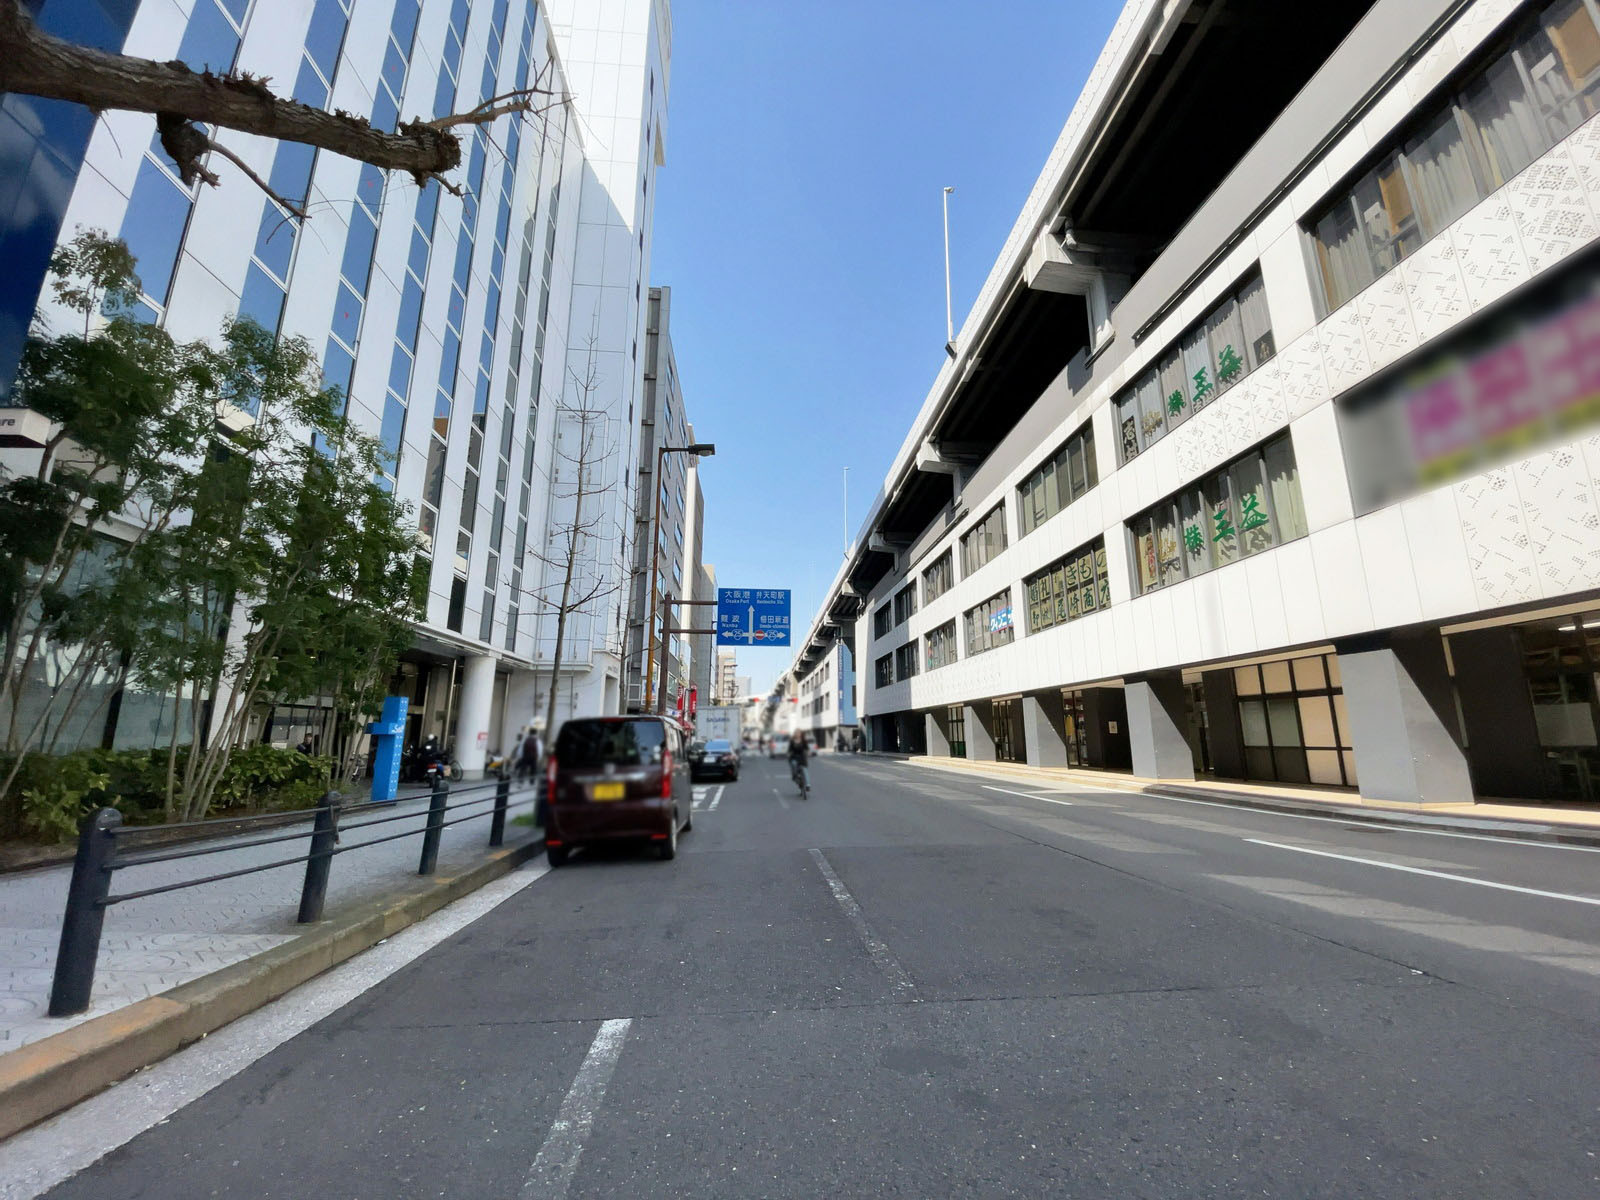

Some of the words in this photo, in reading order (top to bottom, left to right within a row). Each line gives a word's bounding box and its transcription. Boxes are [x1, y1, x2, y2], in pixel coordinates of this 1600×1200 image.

[725, 591, 750, 599] 大阪港
[756, 591, 785, 599] 弁天町駅
